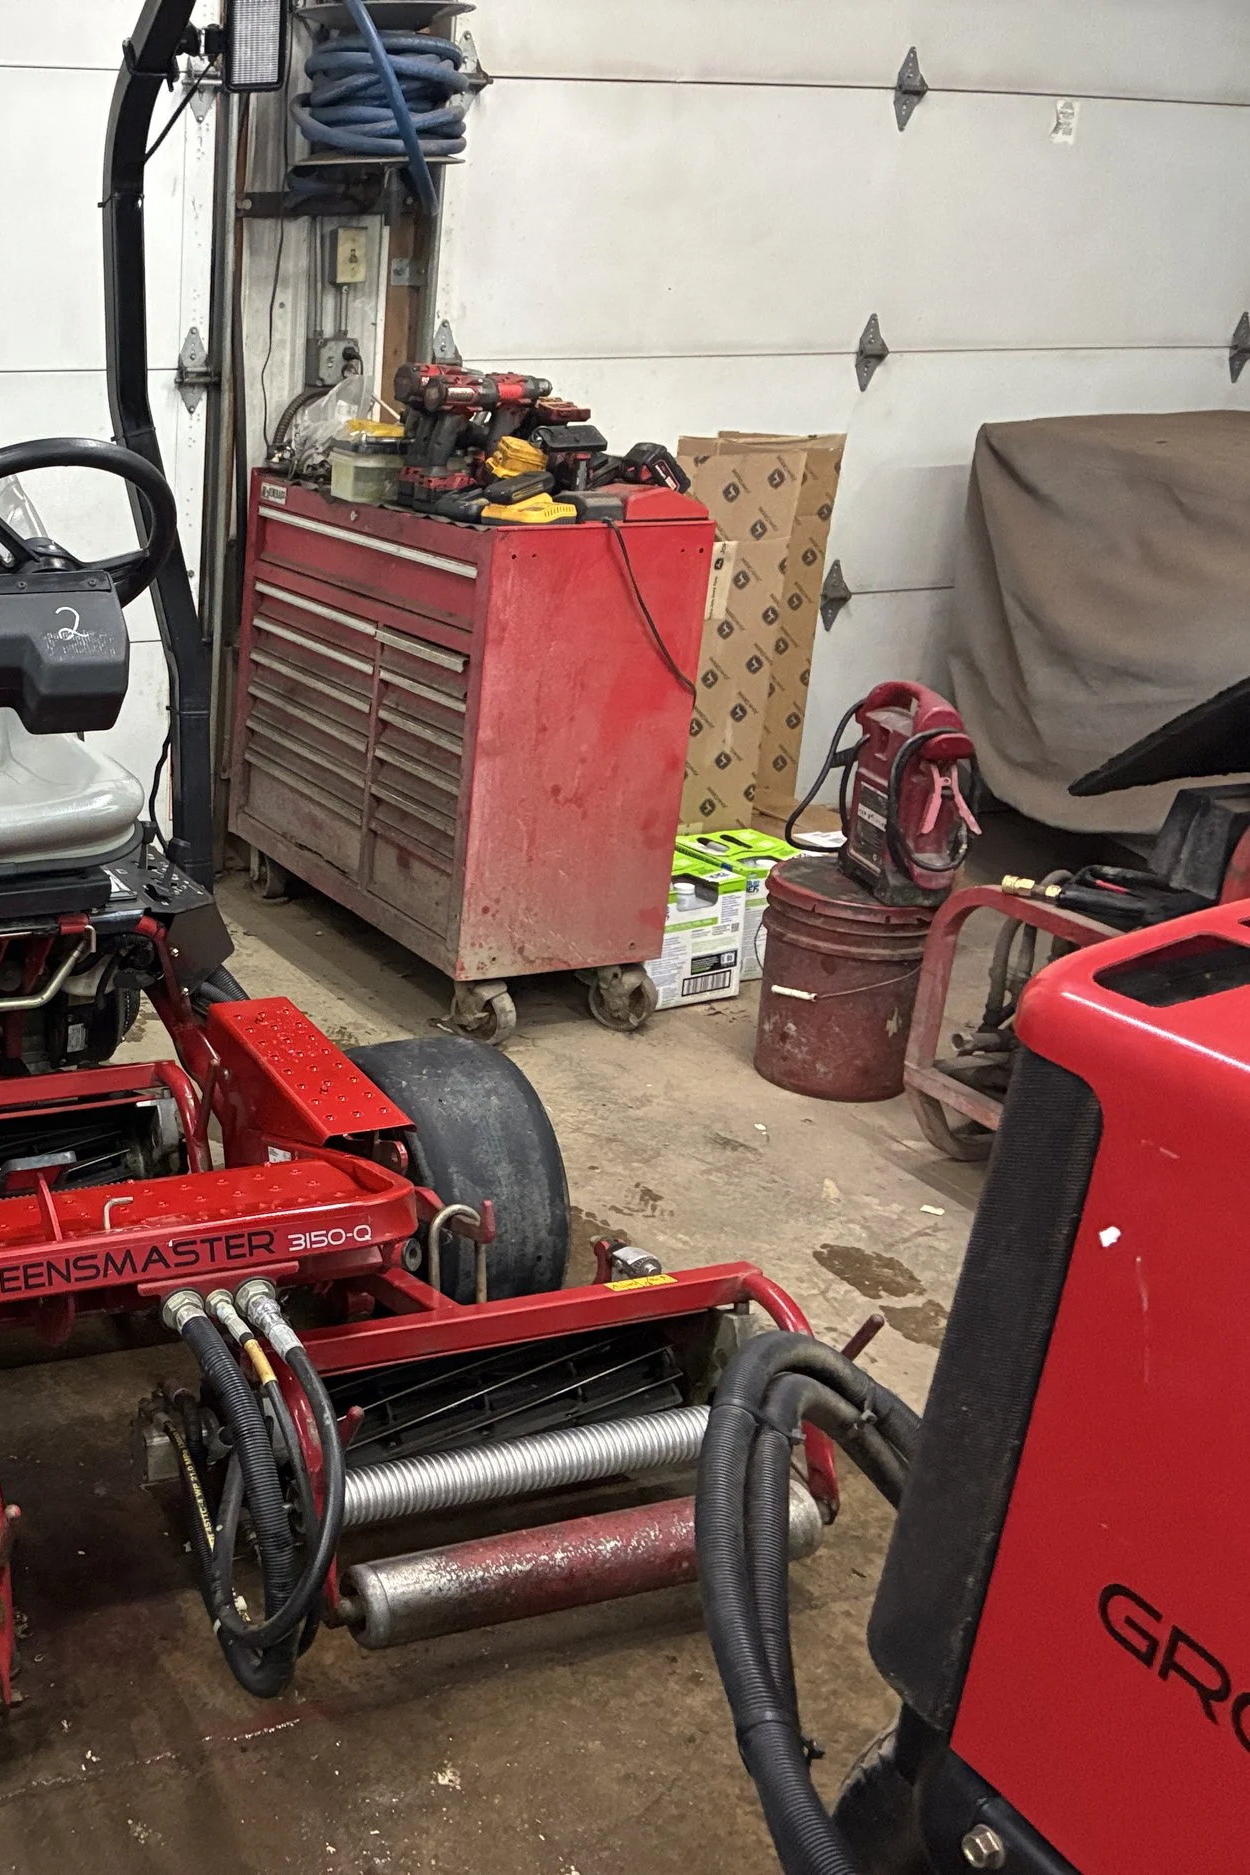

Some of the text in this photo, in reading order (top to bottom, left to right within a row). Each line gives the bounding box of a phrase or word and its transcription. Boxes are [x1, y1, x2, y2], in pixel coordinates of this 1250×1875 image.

[55, 606, 89, 641] 2
[287, 1223, 372, 1253] 3150-Q
[1098, 1583, 1250, 1755] GR
